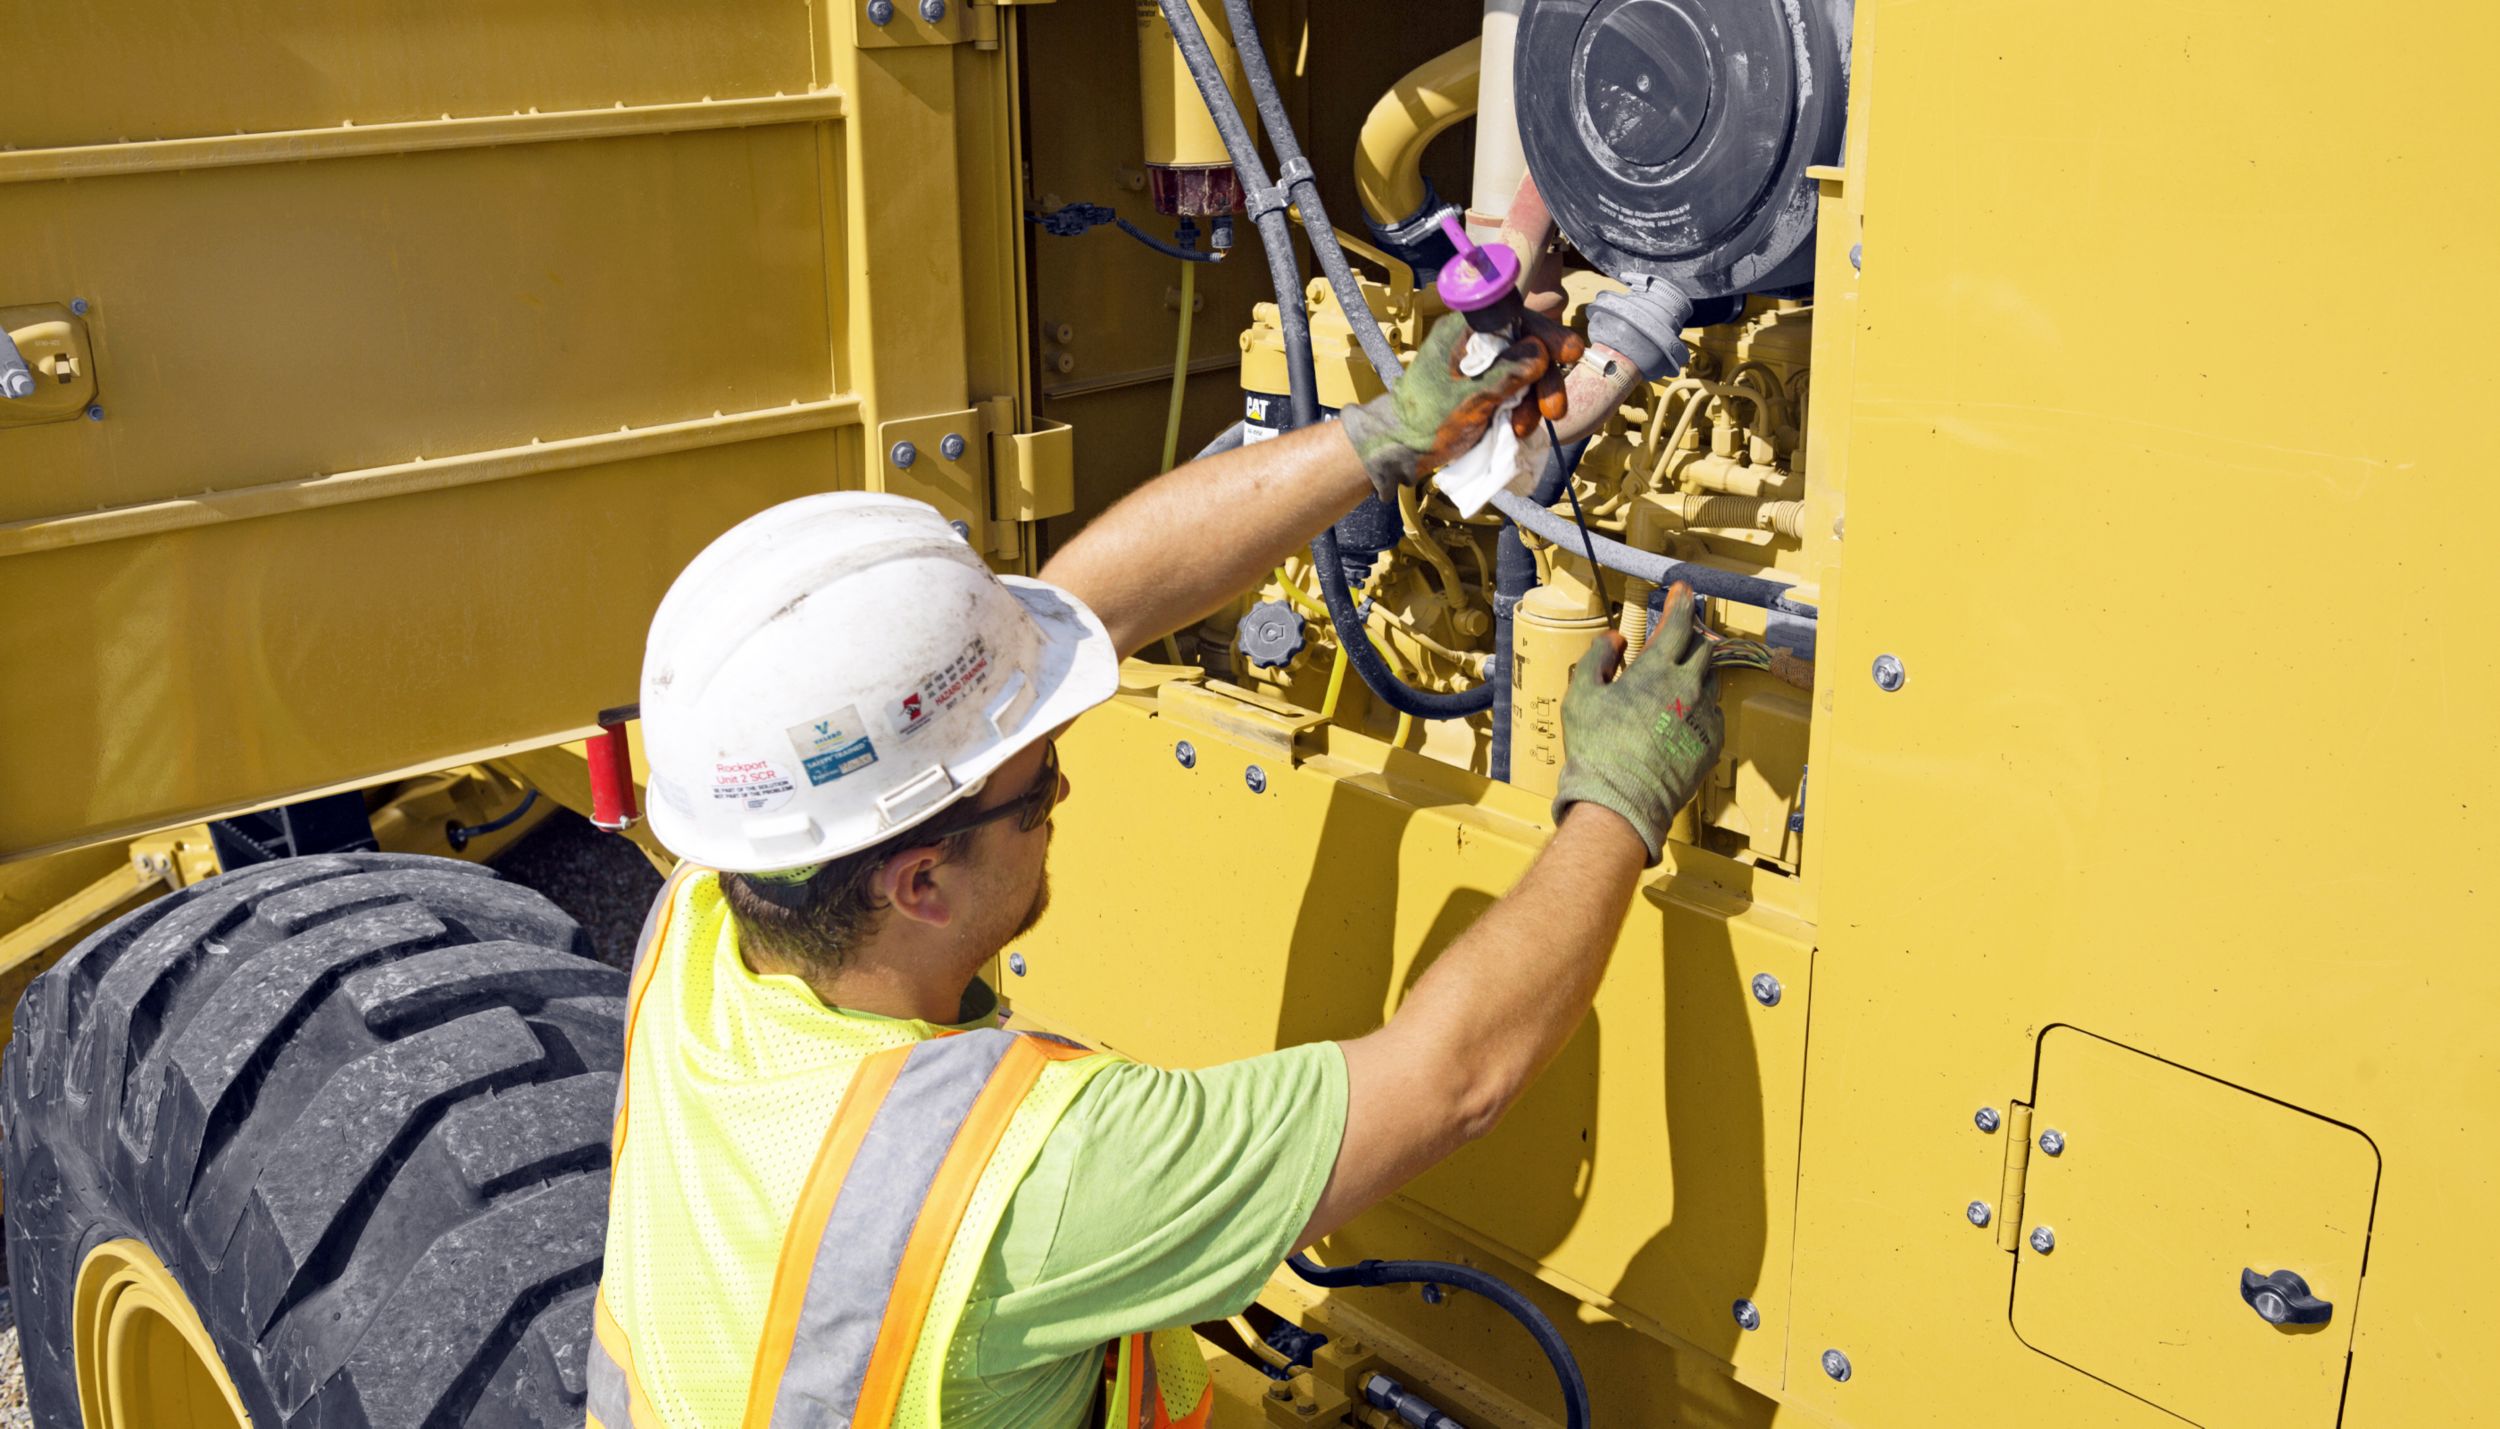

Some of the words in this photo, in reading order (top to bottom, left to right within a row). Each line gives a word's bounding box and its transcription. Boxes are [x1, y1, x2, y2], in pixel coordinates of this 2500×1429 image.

[1246, 396, 1269, 421] CAT
[935, 681, 961, 705] HAZARD
[961, 657, 988, 685] TRAINING
[716, 761, 768, 773] Rockport
[717, 775, 738, 785] Unit
[741, 774, 747, 783] 2
[750, 770, 776, 781] SCR
